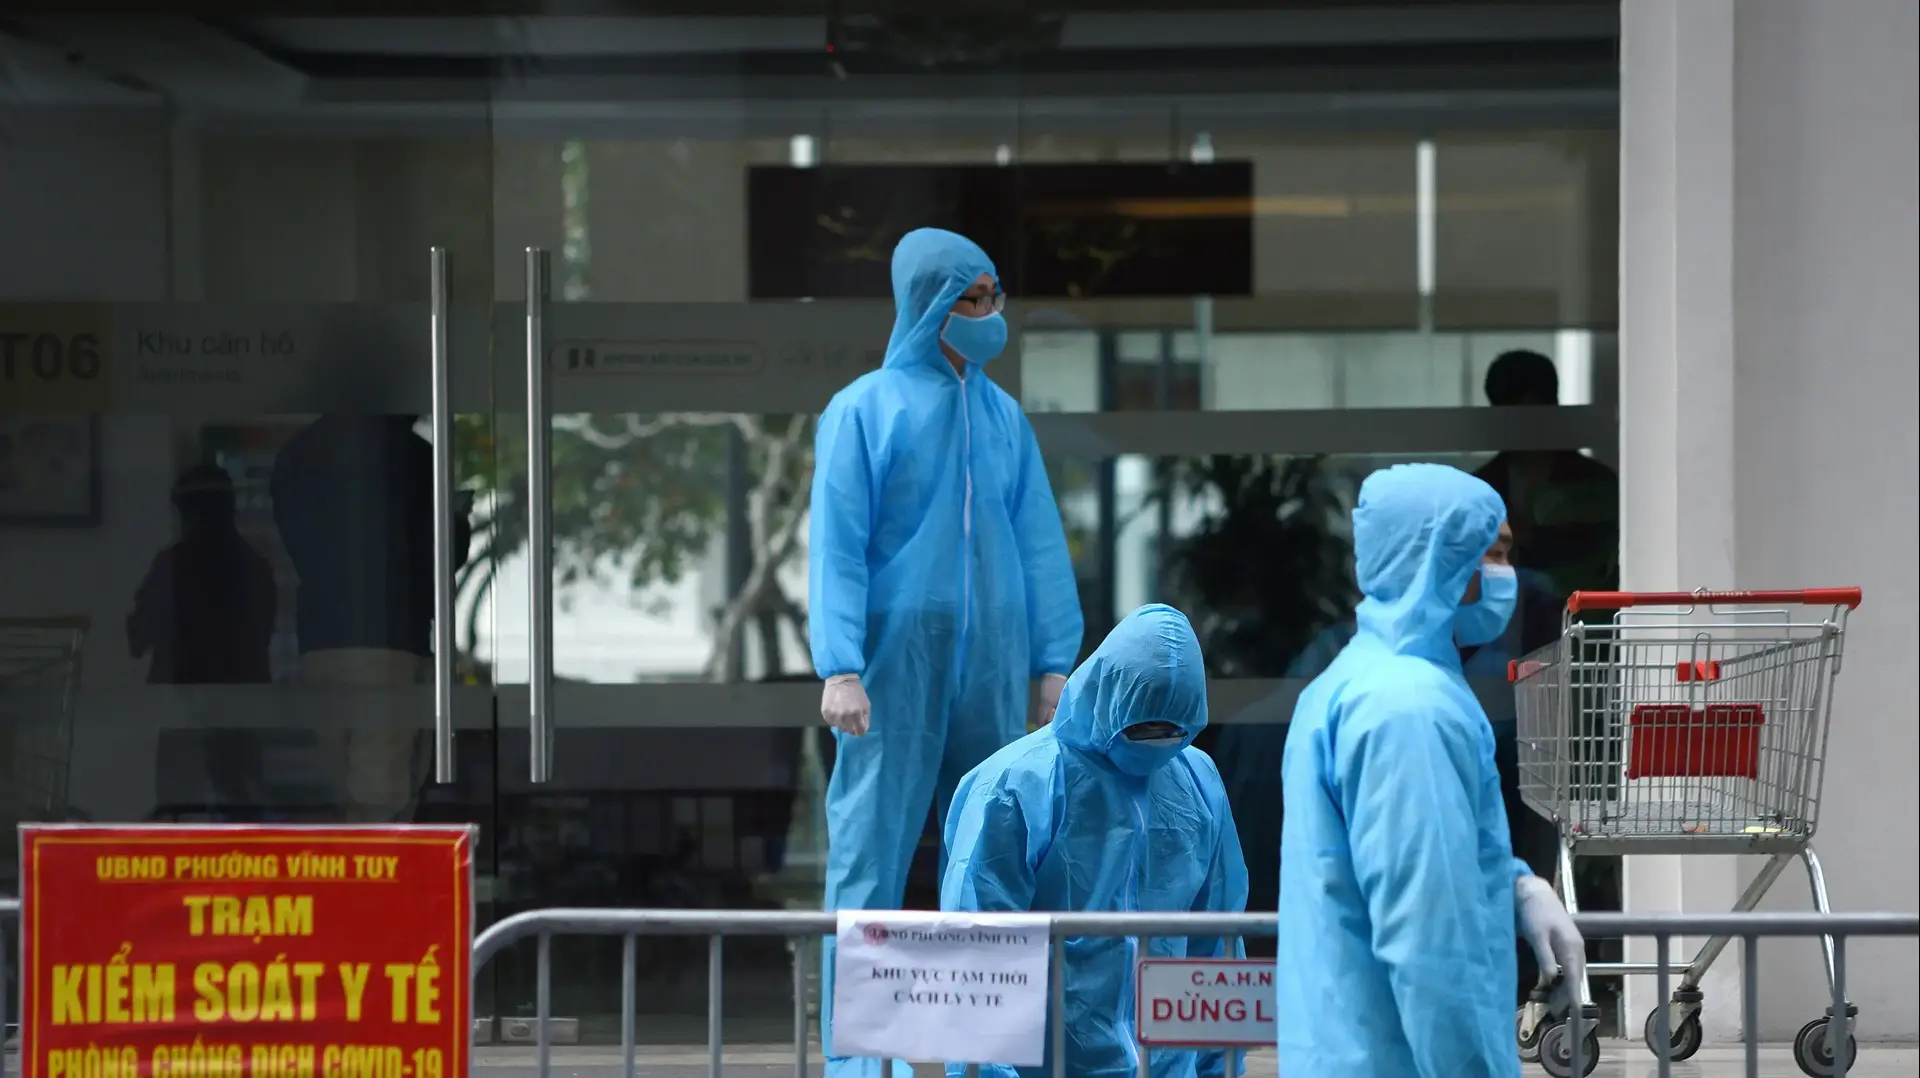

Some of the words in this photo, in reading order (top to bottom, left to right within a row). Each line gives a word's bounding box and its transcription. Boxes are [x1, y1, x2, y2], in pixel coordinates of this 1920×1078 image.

[0, 333, 101, 380] T06
[137, 329, 191, 355] Khu
[97, 855, 166, 879] UBND
[175, 850, 278, 879] PHƯỜNG
[353, 855, 398, 879] TUY
[183, 895, 313, 944] TRẠM
[51, 942, 175, 1025] KIỂM
[193, 953, 324, 1023] SOÁT
[339, 963, 370, 1022] Y
[385, 944, 441, 1024] TẾ
[872, 967, 907, 980] KHU
[1152, 989, 1247, 1022] DỪNG
[1256, 999, 1274, 1022] L
[323, 1045, 442, 1078] COVID-19
